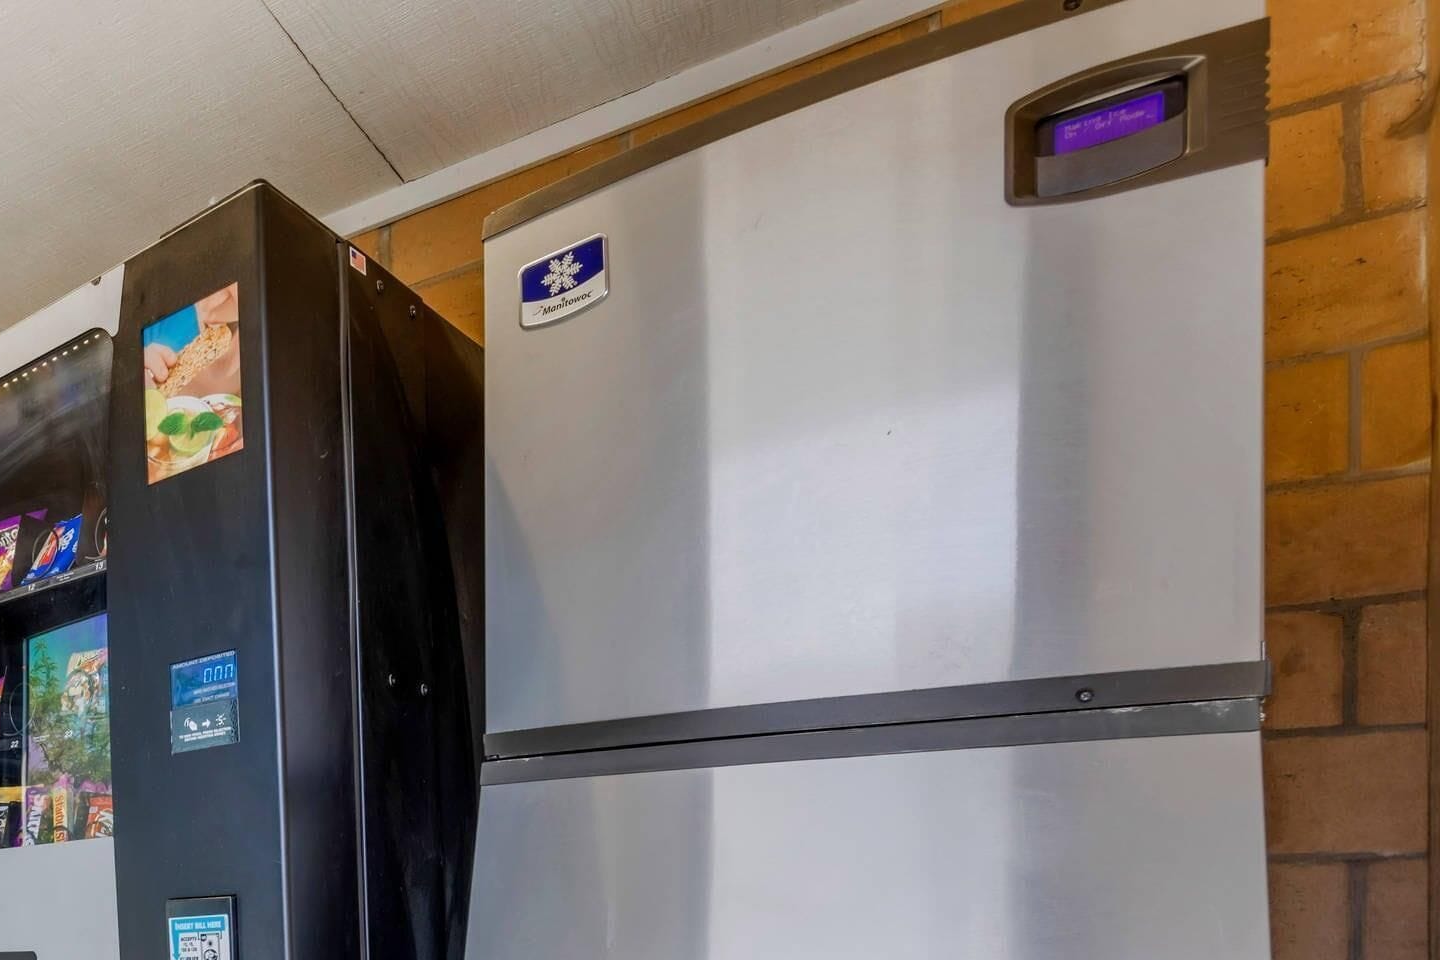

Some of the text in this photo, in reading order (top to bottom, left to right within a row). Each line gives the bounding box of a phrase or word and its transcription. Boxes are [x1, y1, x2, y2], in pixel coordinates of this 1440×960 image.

[542, 289, 593, 316] Manitowoc
[10, 740, 19, 749] 22
[207, 919, 222, 929] HERE
